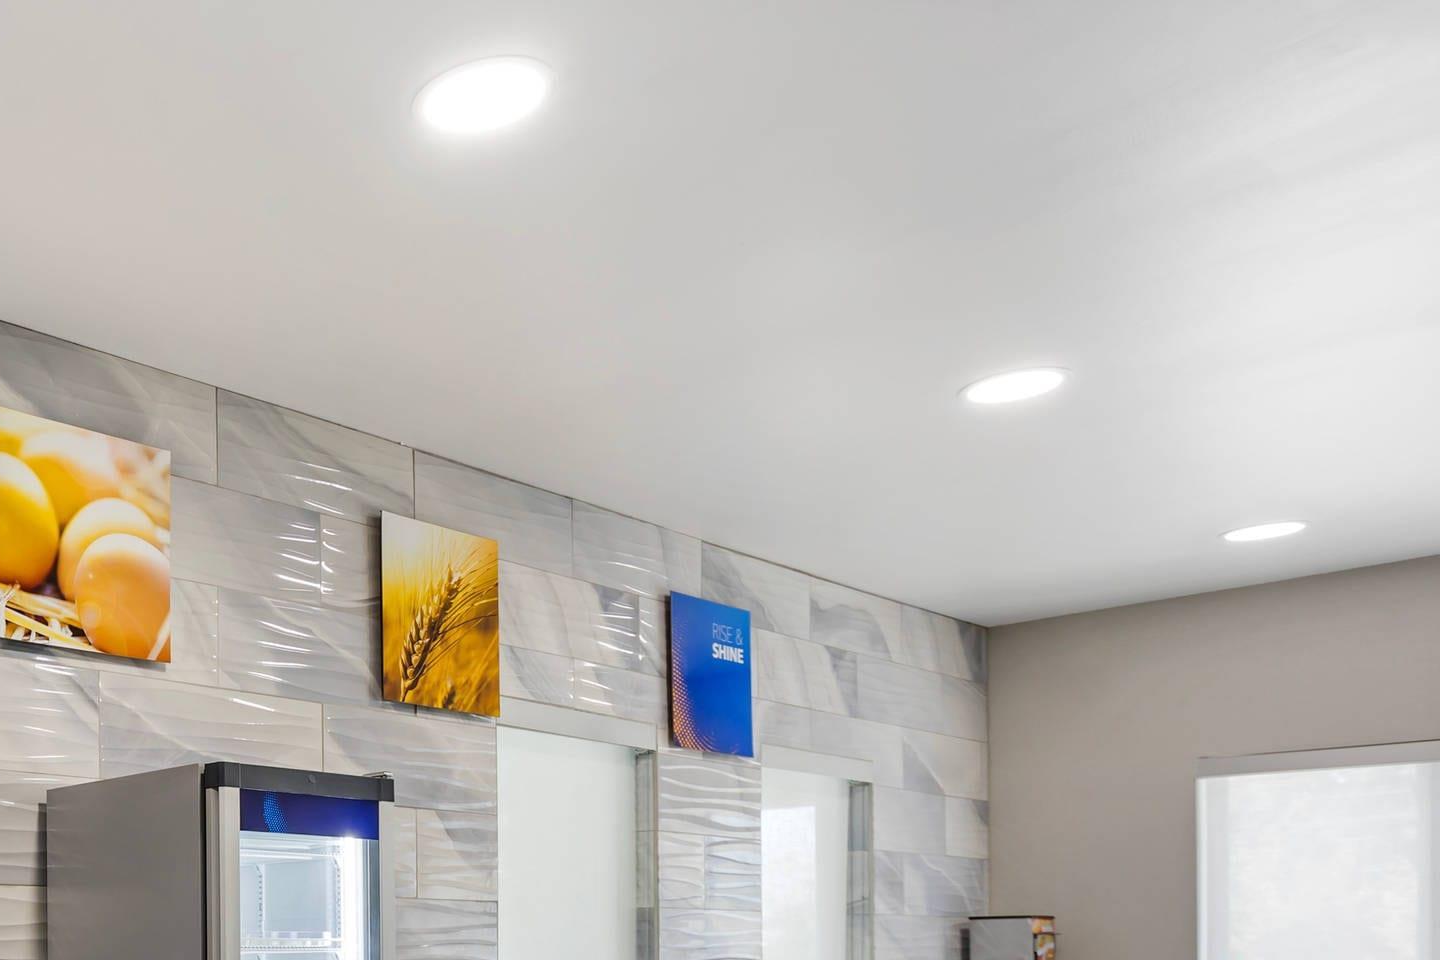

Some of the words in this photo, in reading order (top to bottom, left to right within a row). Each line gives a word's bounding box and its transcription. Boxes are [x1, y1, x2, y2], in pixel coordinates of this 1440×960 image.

[712, 622, 734, 644] RISE
[735, 628, 743, 646] &
[712, 642, 744, 664] SHINE
